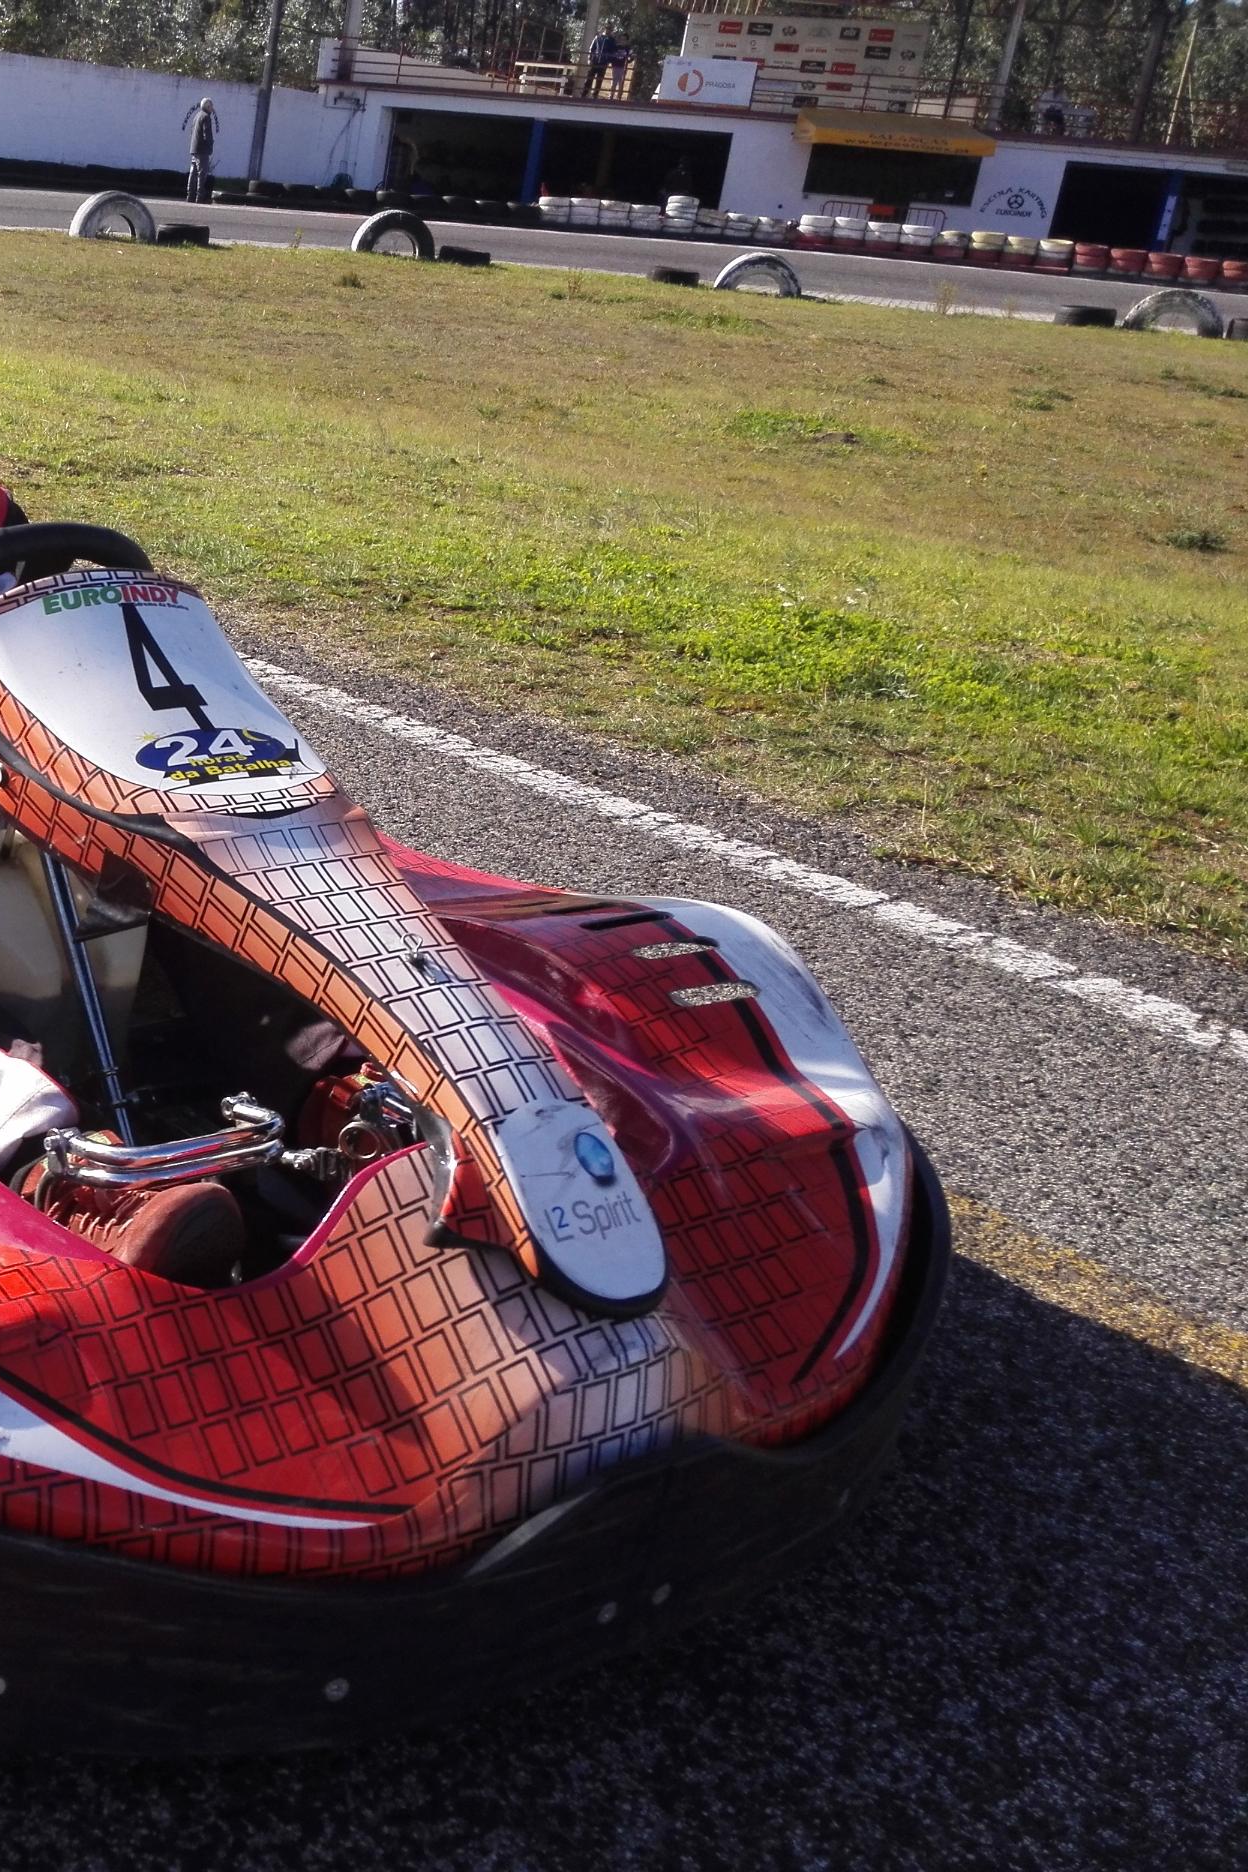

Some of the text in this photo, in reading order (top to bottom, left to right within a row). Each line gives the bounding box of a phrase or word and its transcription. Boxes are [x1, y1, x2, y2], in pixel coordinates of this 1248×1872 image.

[979, 187, 1048, 219] ESCOLA KARTING
[41, 584, 180, 616] EUROINDY
[122, 602, 215, 731] 4
[154, 729, 256, 767] 24
[188, 753, 248, 767] horas
[169, 758, 293, 782] da Batalha
[571, 1190, 642, 1240] Spirit
